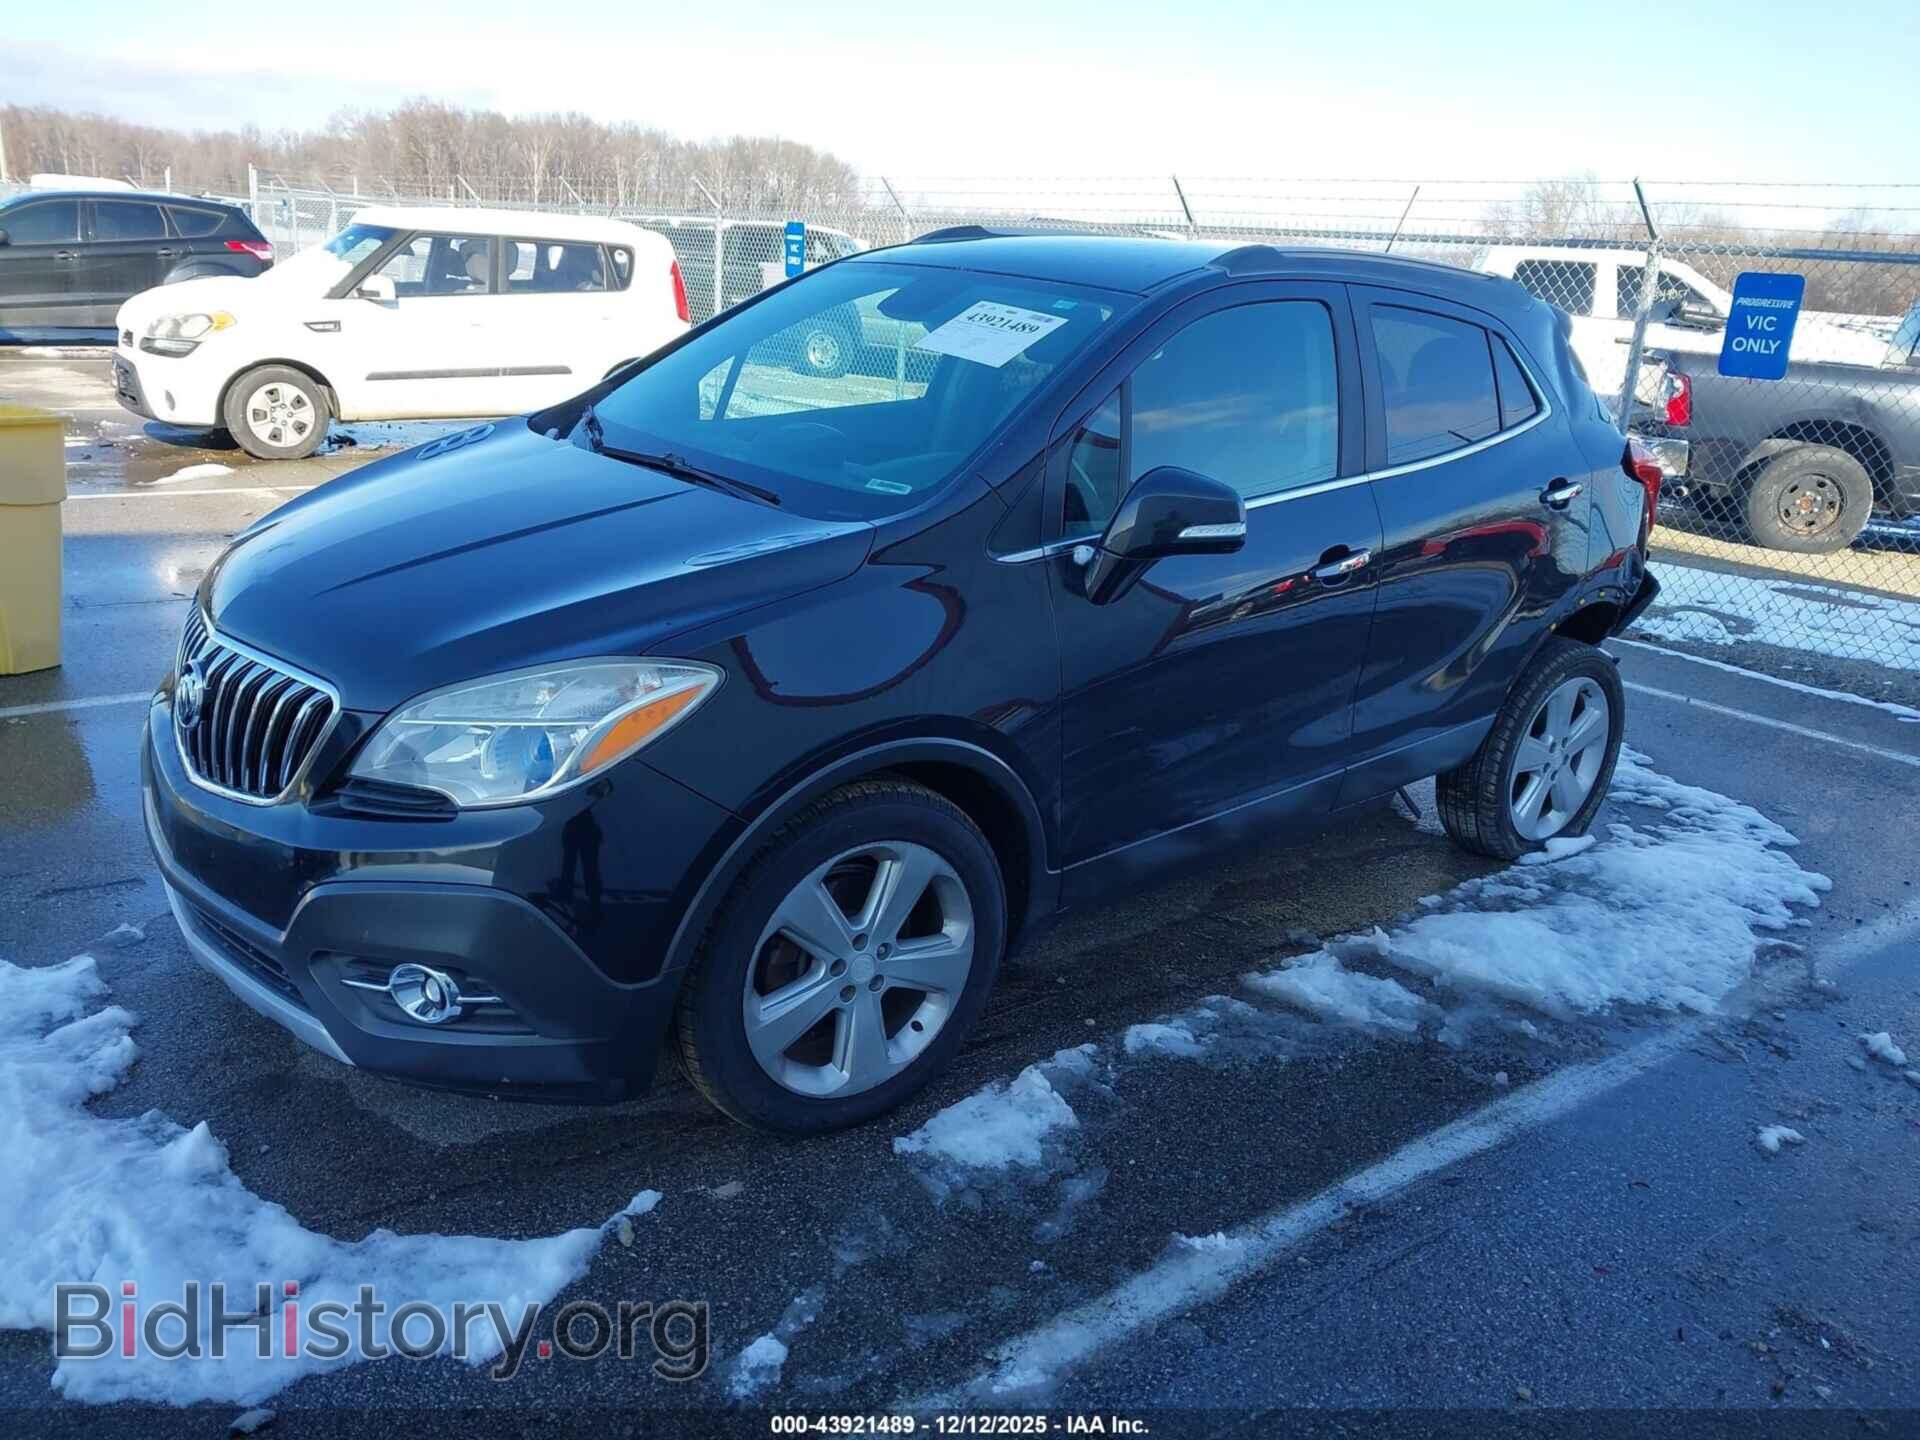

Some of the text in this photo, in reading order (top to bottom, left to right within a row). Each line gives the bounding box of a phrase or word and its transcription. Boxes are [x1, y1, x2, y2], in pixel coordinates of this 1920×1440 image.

[967, 312, 1041, 334] 43921489
[1746, 314, 1777, 331] VIC
[1732, 337, 1781, 354] ONLY
